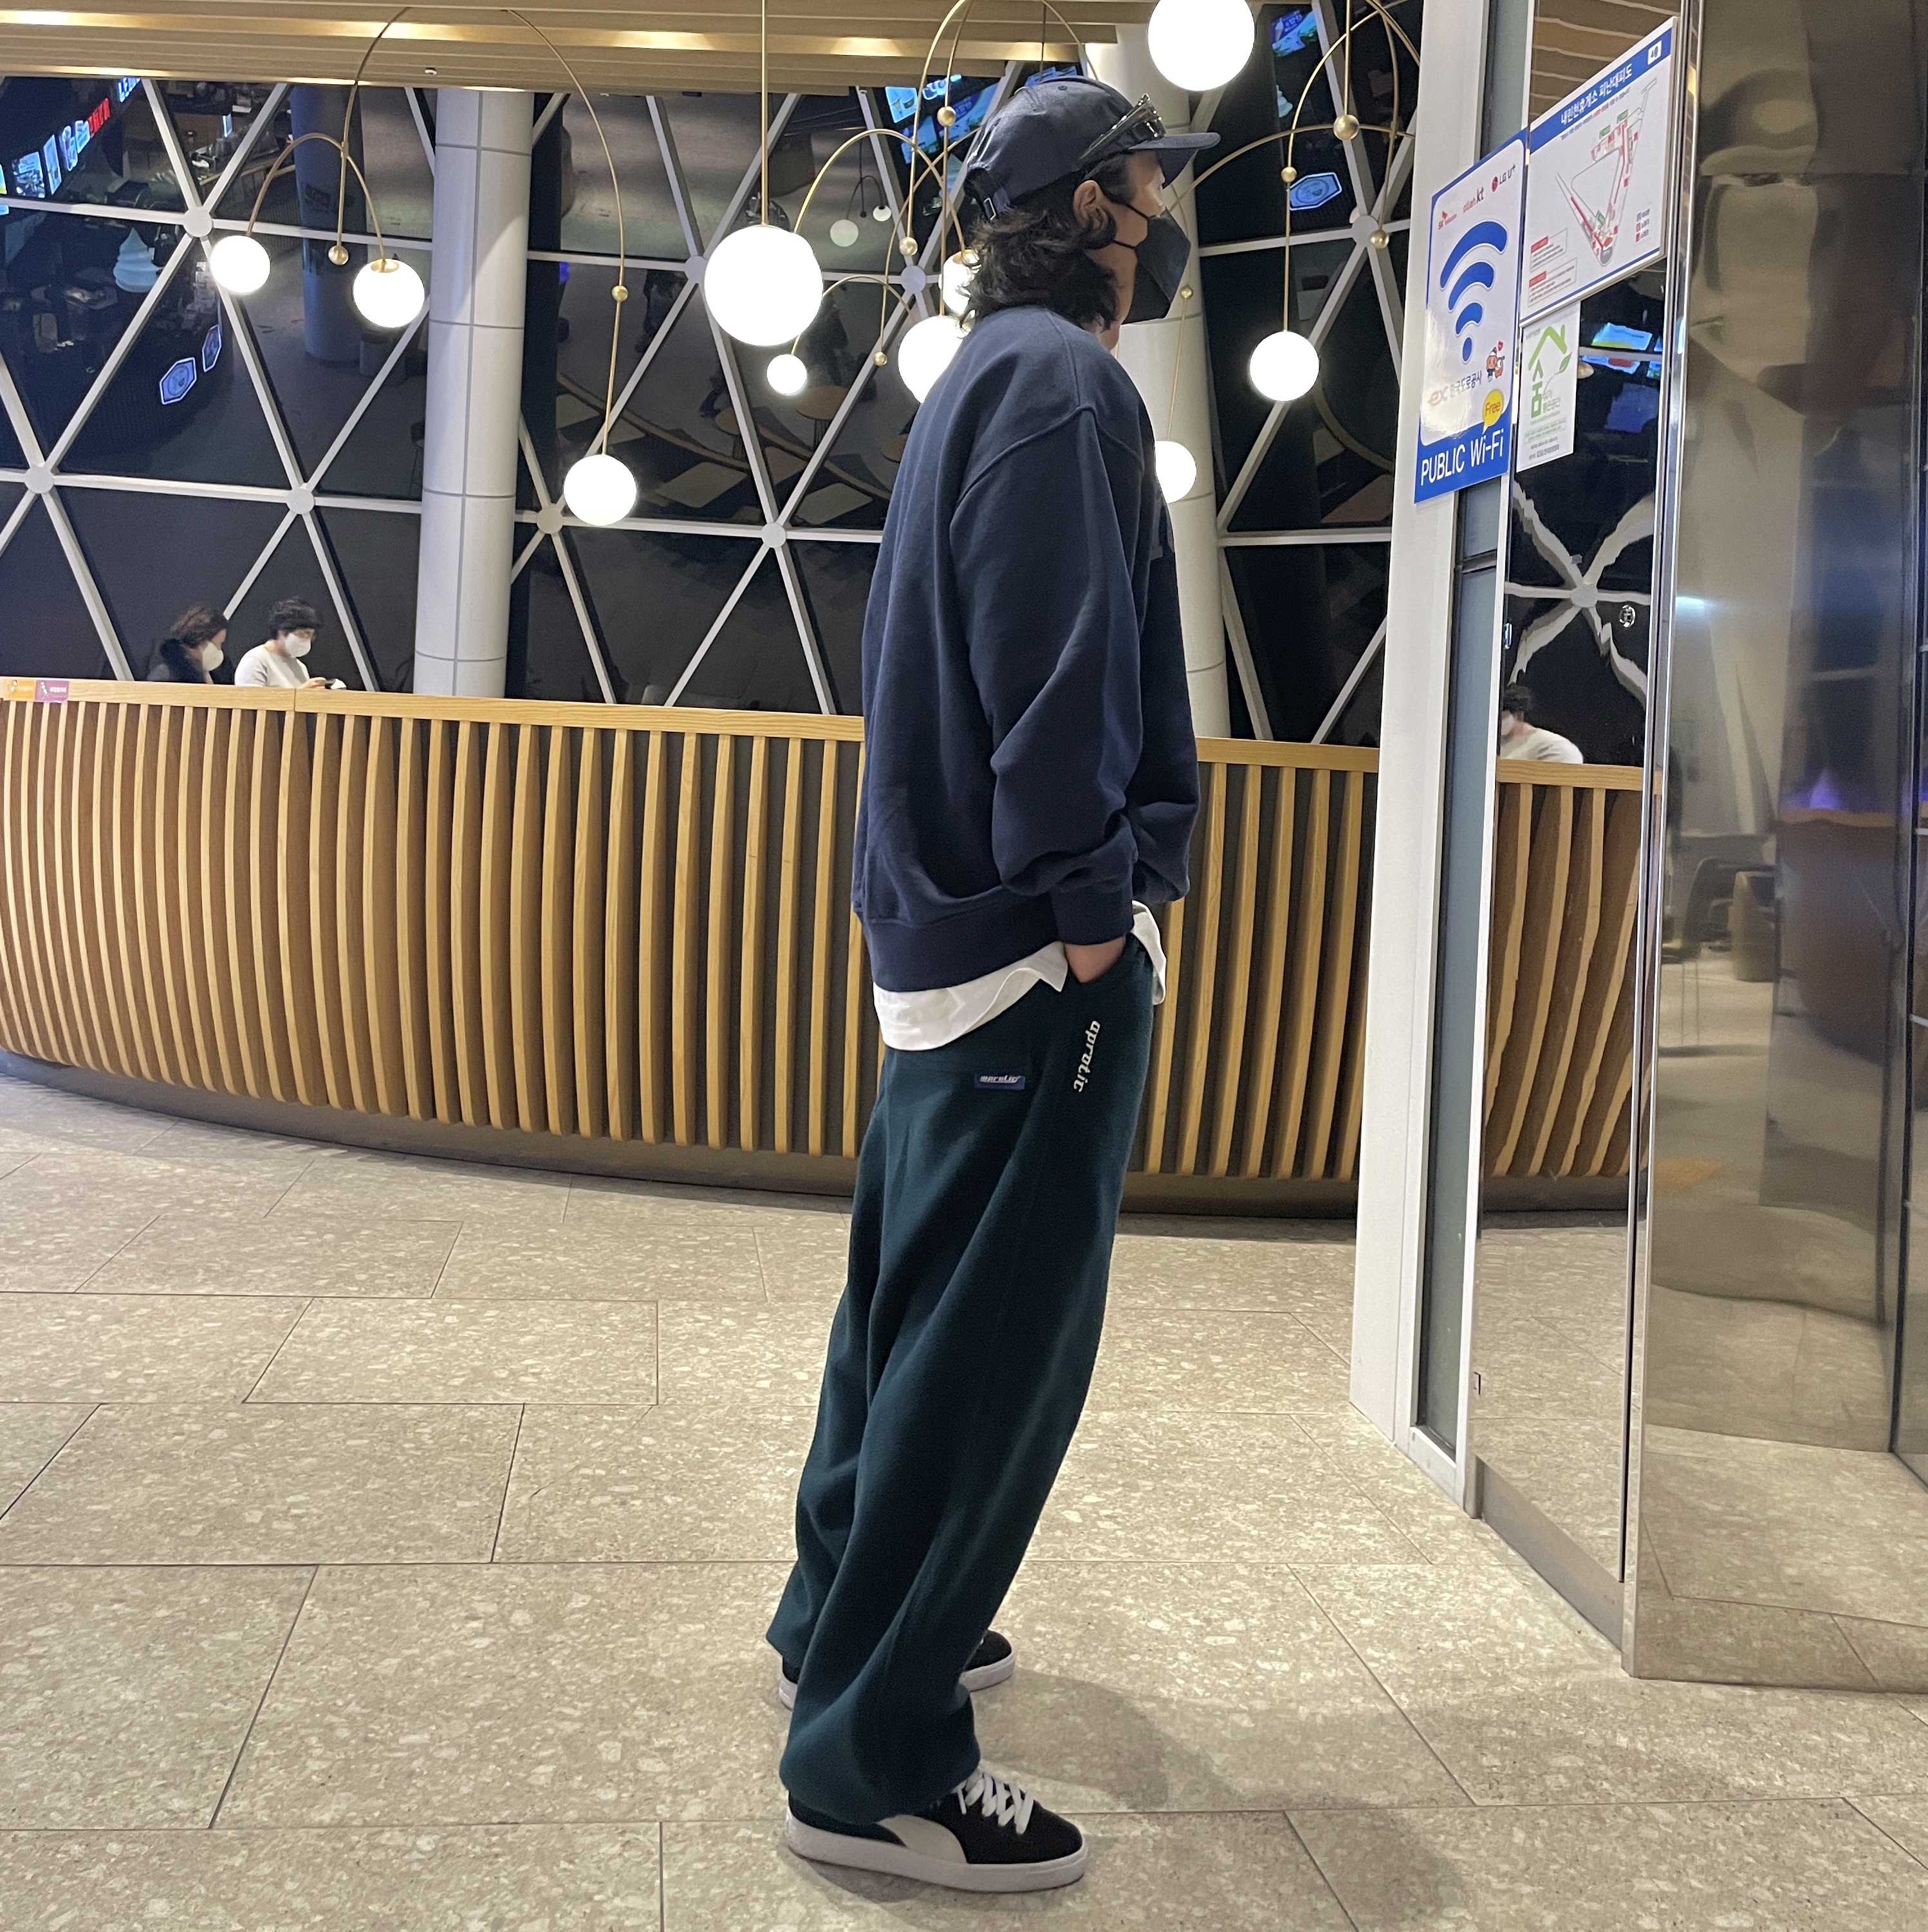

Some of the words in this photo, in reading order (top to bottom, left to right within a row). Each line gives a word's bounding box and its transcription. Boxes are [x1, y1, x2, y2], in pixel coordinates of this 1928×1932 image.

[1561, 89, 1598, 125] 내린천휴게소
[1599, 64, 1633, 98] 피난대피도
[1499, 172, 1506, 185] LG
[1485, 401, 1501, 417] Free
[1420, 444, 1466, 487] PUBLIC
[1470, 428, 1505, 468] Wi-Fi
[1073, 1020, 1101, 1093] aprotic
